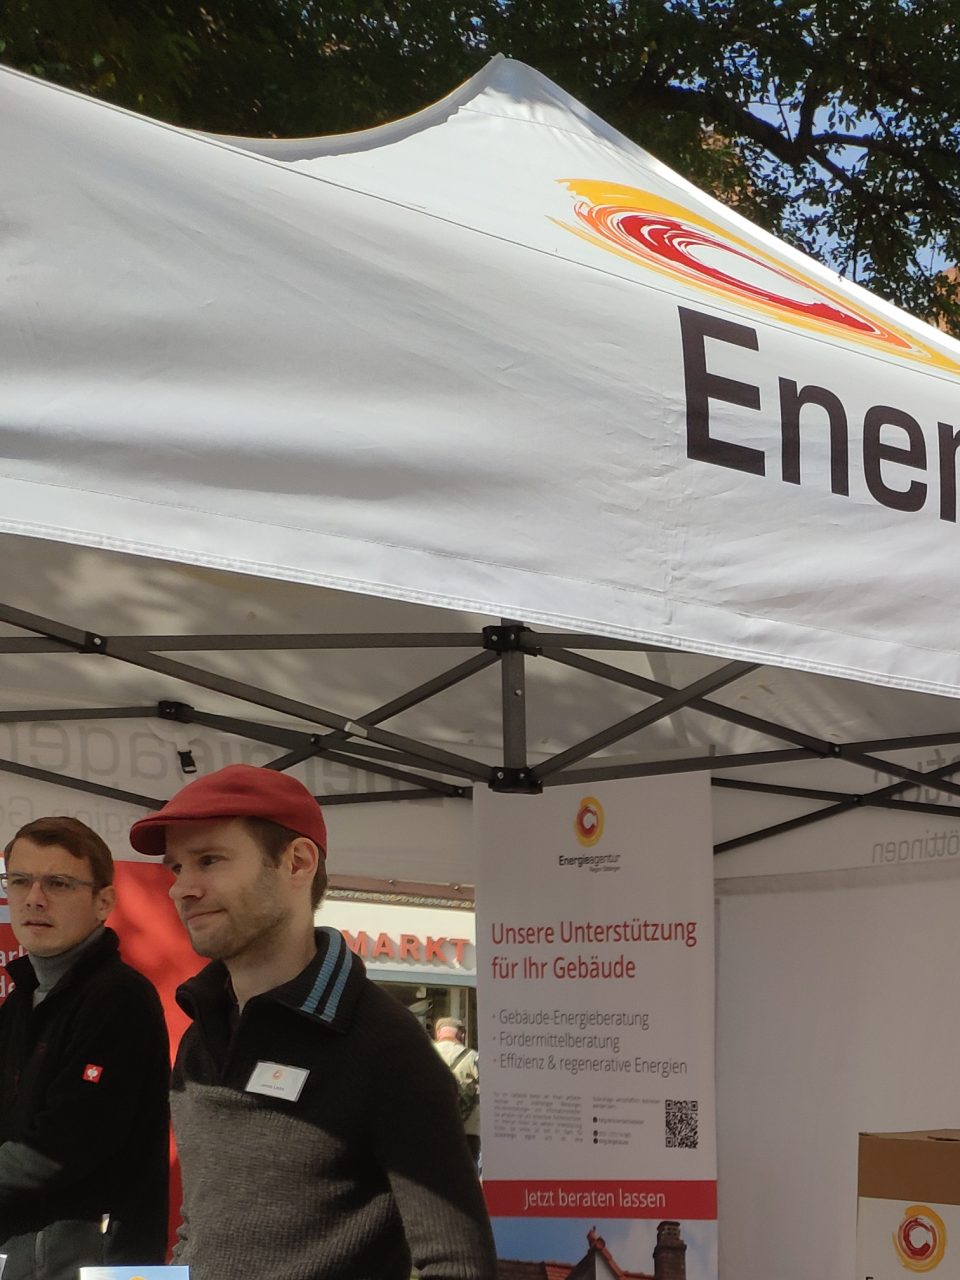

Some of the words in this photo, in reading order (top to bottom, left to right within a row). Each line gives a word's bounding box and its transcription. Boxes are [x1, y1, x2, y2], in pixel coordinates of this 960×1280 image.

[491, 922, 555, 945] Unsere
[560, 918, 698, 948] Unterstützung
[340, 930, 470, 965] MARKT
[492, 956, 518, 979] für
[523, 957, 548, 979] Ihr
[553, 955, 636, 979] Gebäude
[499, 1008, 649, 1030] Gebäude-Energieberatung
[500, 1032, 620, 1053] Fördermittelberatung
[500, 1052, 544, 1070] Effizienz
[547, 1054, 557, 1071] &
[560, 1056, 631, 1075] regenerative
[634, 1057, 688, 1078] Energien
[524, 1188, 554, 1210] Jetzt
[558, 1188, 615, 1207] beraten
[619, 1189, 666, 1208] lassen
